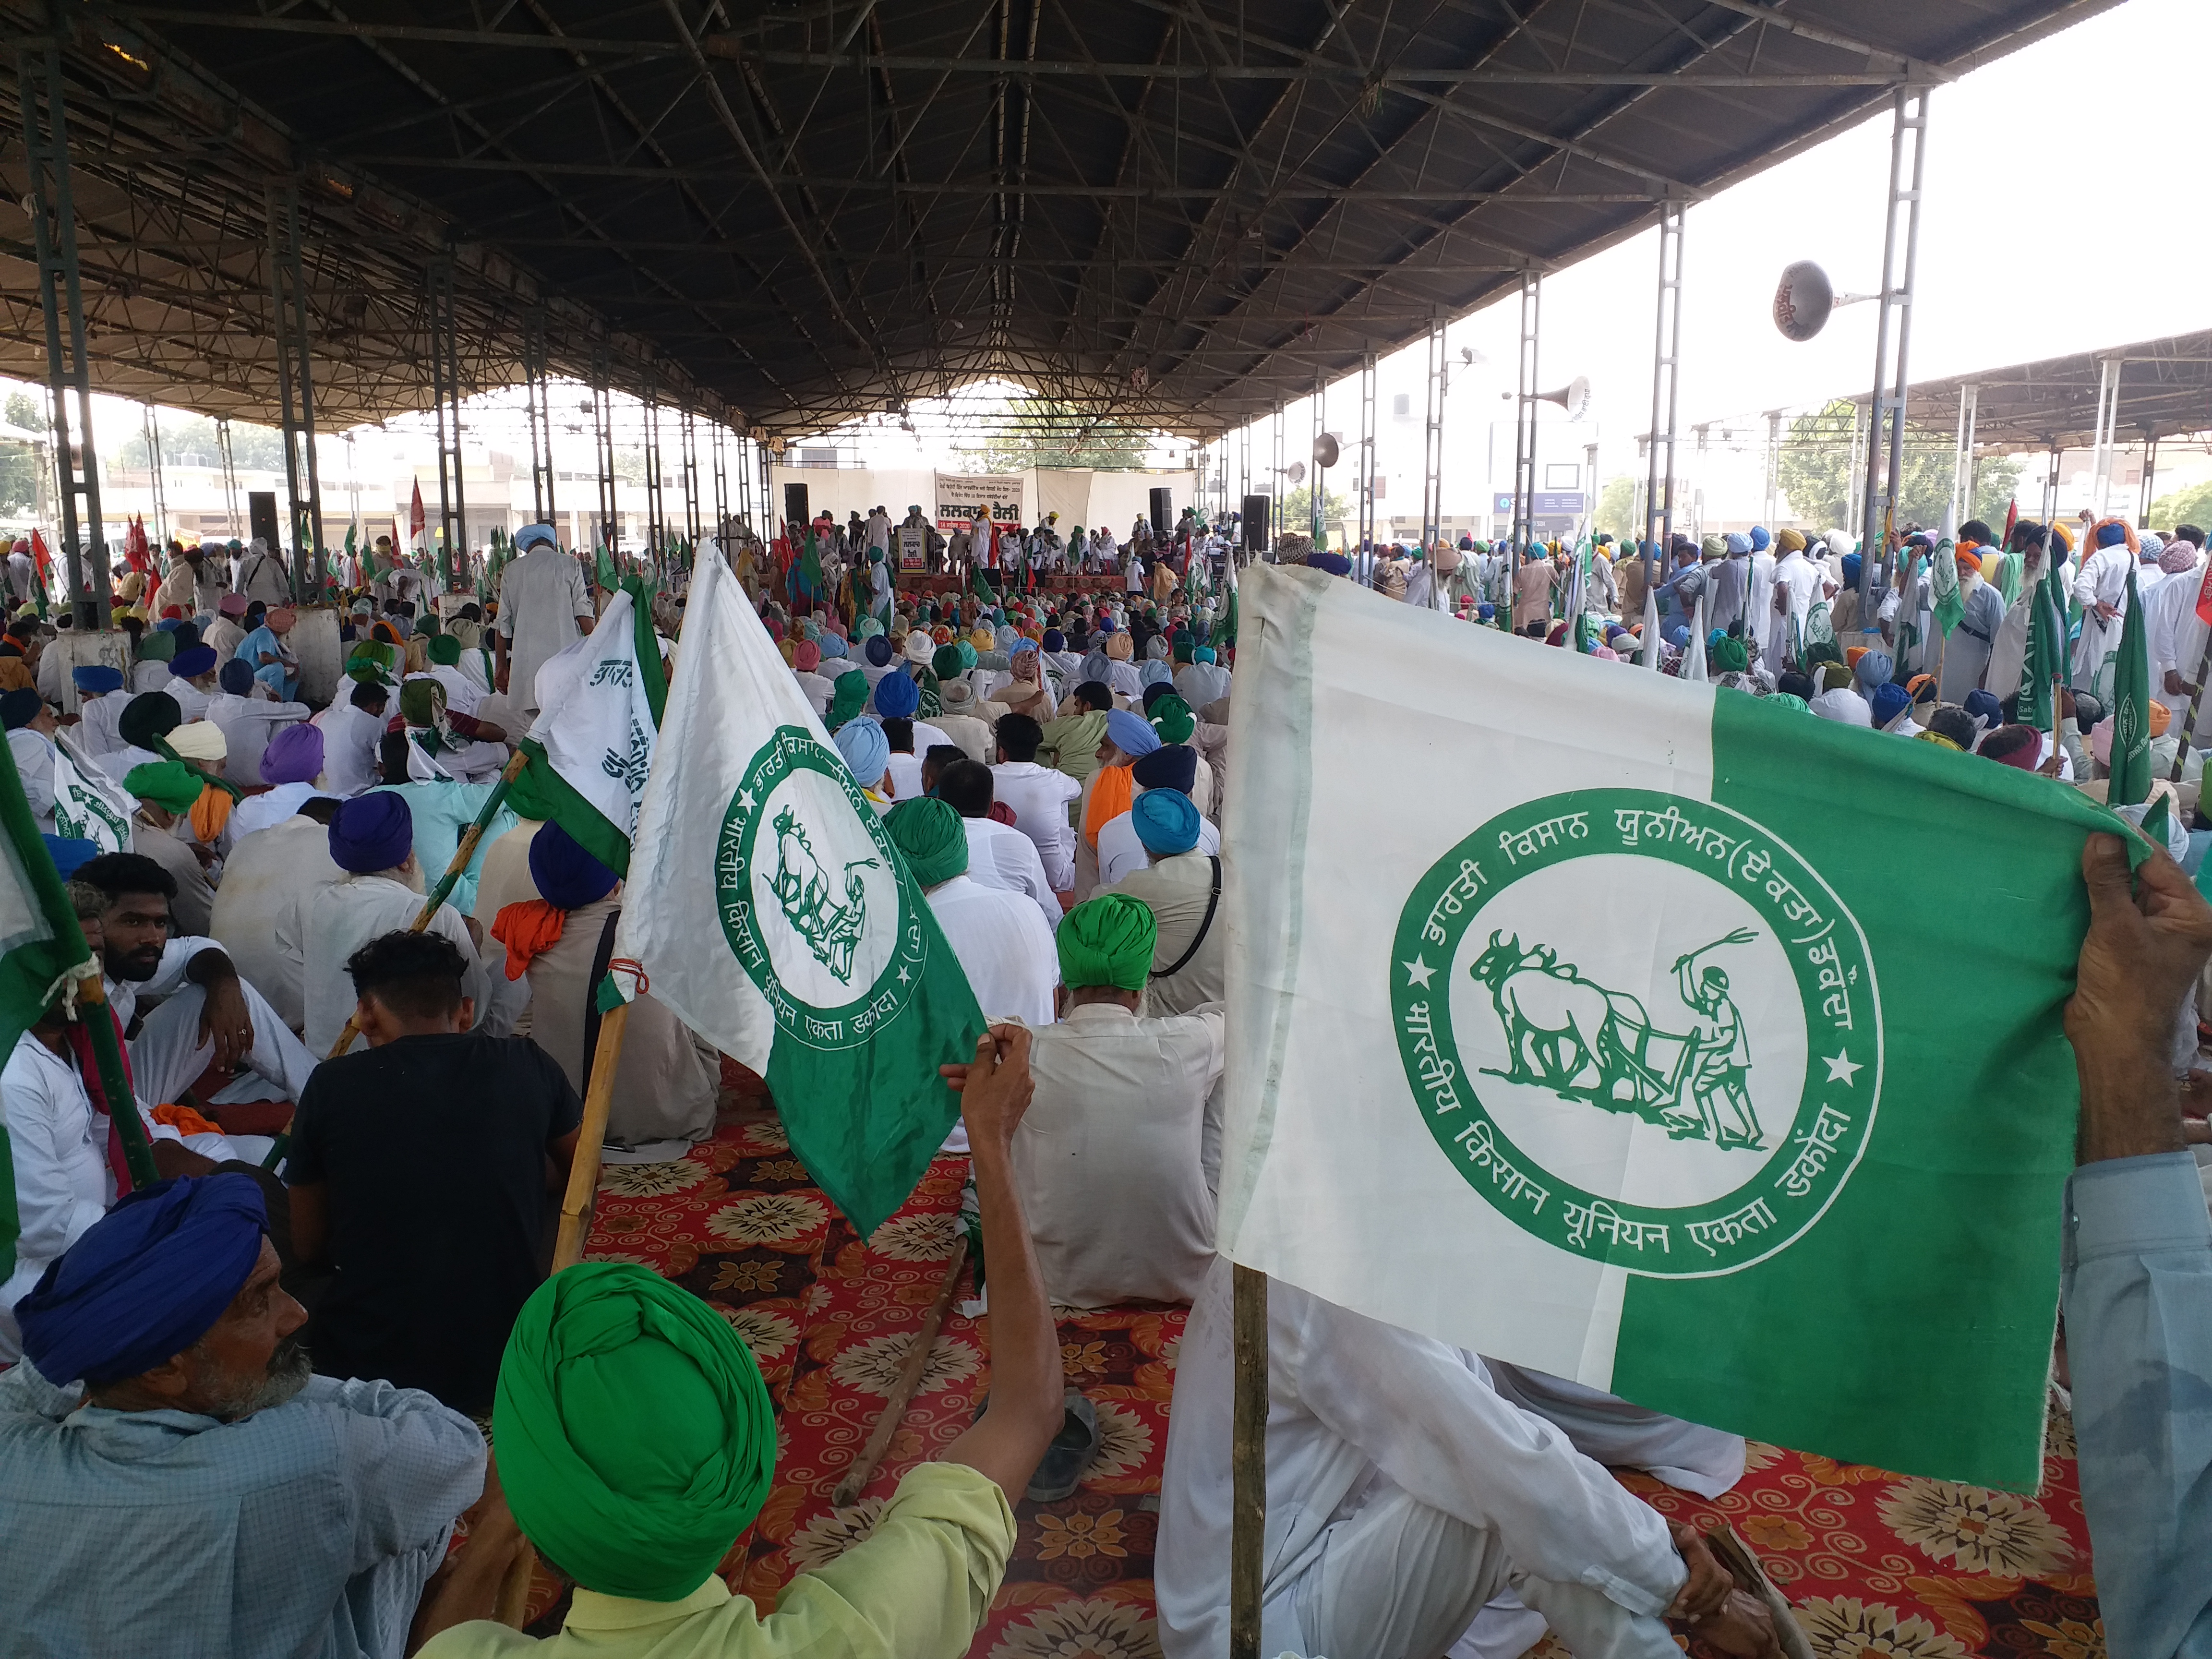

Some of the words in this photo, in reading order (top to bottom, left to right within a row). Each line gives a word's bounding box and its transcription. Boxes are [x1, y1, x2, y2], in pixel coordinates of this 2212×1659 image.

[939, 504, 981, 517] ਲਲਕਾ
[992, 501, 1020, 520] ਰੈਲੀ
[907, 549, 917, 557] ਰੈਲੀ
[752, 741, 786, 792] ਭਾਰਤੀ
[720, 817, 746, 890] भारतीय
[1420, 859, 1488, 946] ਭਾਰਤੀ
[1498, 811, 1589, 865] ਕਿਸਾਨ
[723, 899, 765, 969] किसान
[805, 1014, 843, 1040] एकता
[1405, 1000, 1462, 1116] भारतीय
[1454, 1119, 1551, 1215] किसान
[1563, 1200, 1671, 1254] यूनियन
[1683, 1196, 1779, 1257] एकता
[1773, 1102, 1851, 1197] डकोंदा
